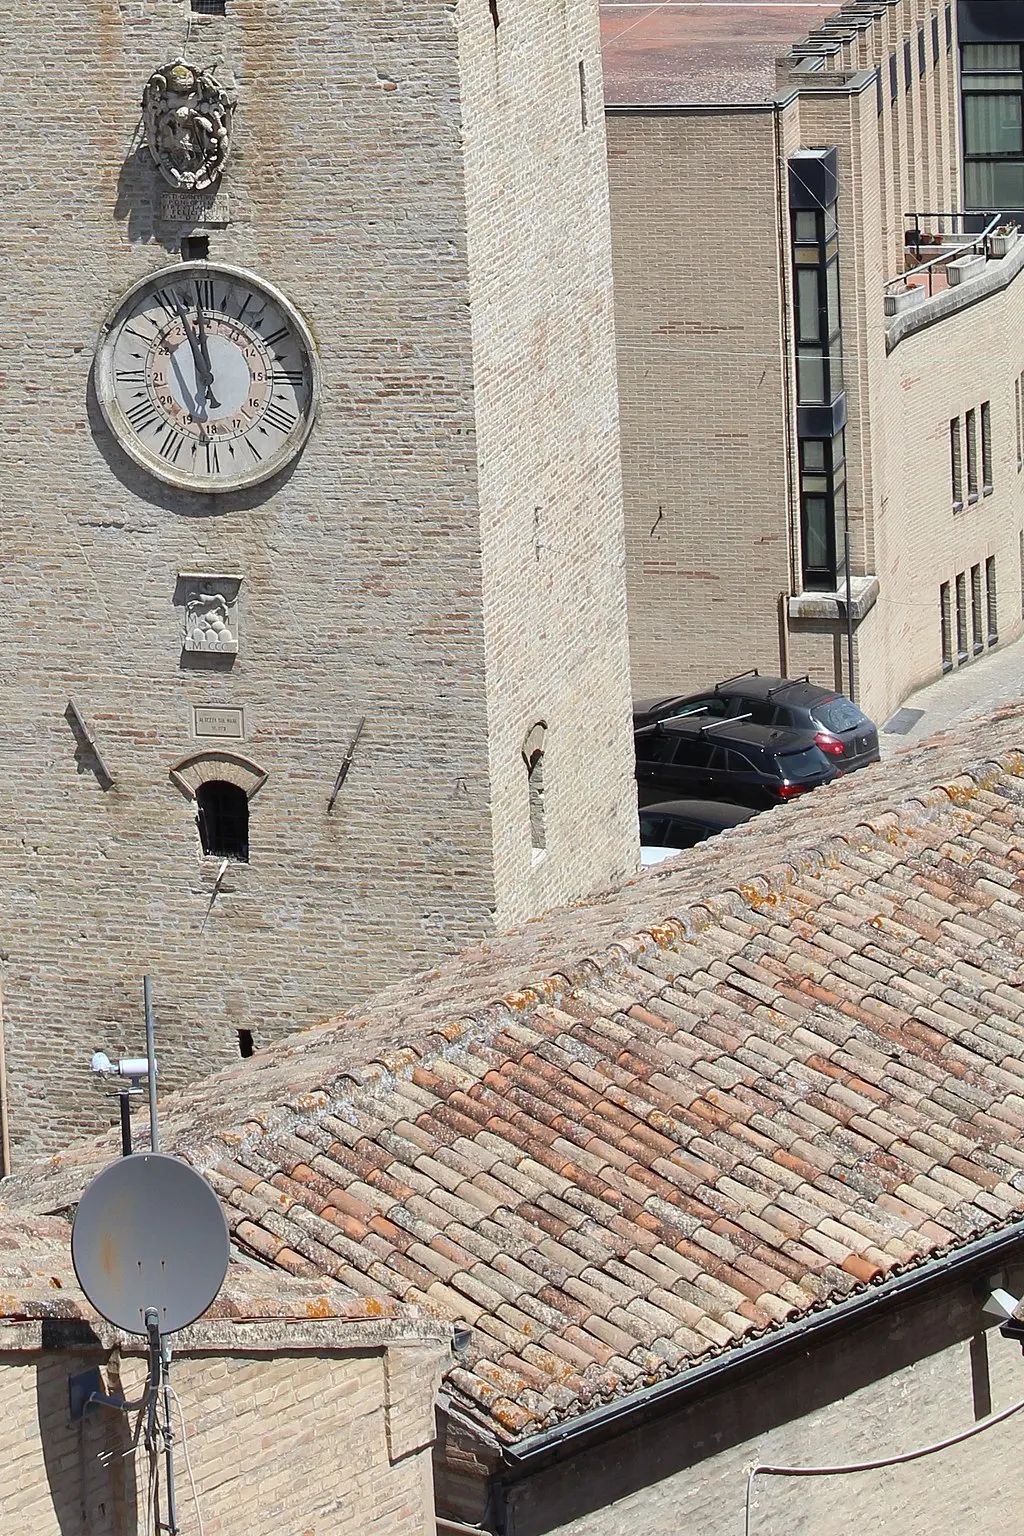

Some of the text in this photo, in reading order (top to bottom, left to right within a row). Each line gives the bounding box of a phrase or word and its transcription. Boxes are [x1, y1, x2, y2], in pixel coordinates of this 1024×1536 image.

[194, 280, 215, 310] XII
[175, 326, 187, 336] 23
[229, 328, 240, 342] 13
[261, 326, 291, 347] II
[158, 347, 170, 356] 22
[244, 348, 257, 358] 14
[153, 372, 163, 382] 21
[252, 372, 263, 382] 15
[273, 370, 303, 386] III
[160, 395, 173, 406] 20
[249, 398, 260, 408] 16
[182, 415, 193, 425] 19
[231, 418, 242, 429] 17
[206, 424, 217, 434] 18
